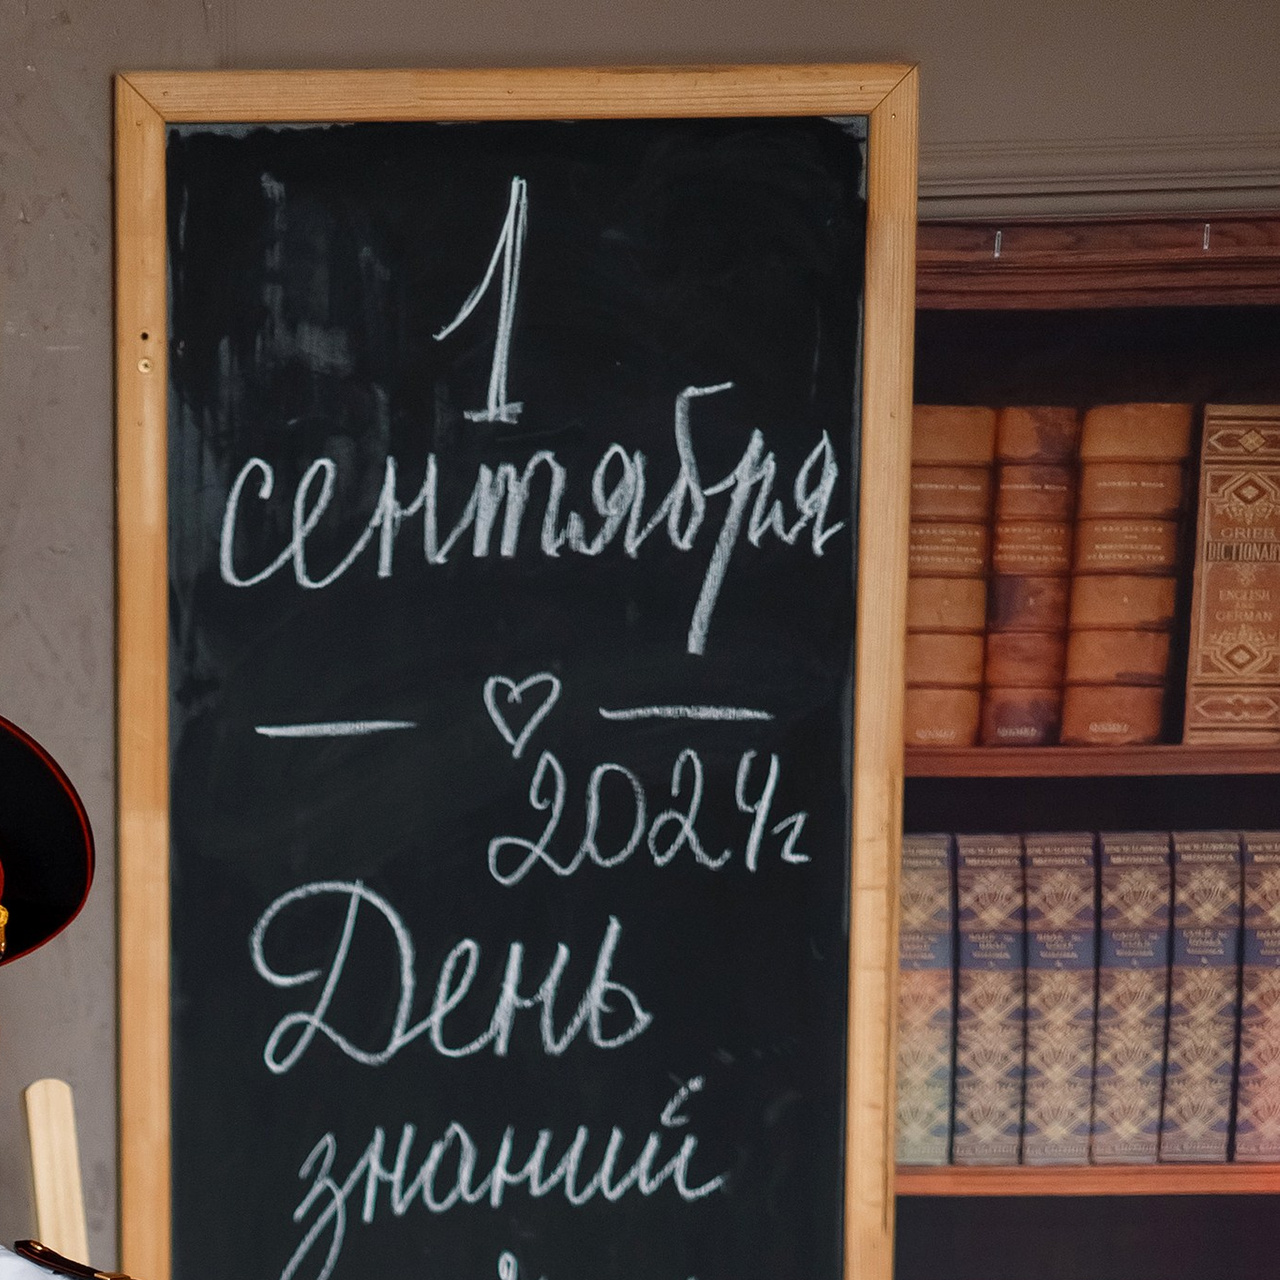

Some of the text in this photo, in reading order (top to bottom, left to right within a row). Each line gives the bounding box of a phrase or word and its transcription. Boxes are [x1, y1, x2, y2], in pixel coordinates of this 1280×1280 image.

[431, 175, 528, 425] 1
[219, 379, 846, 657] сентября
[250, 879, 654, 1074] День
